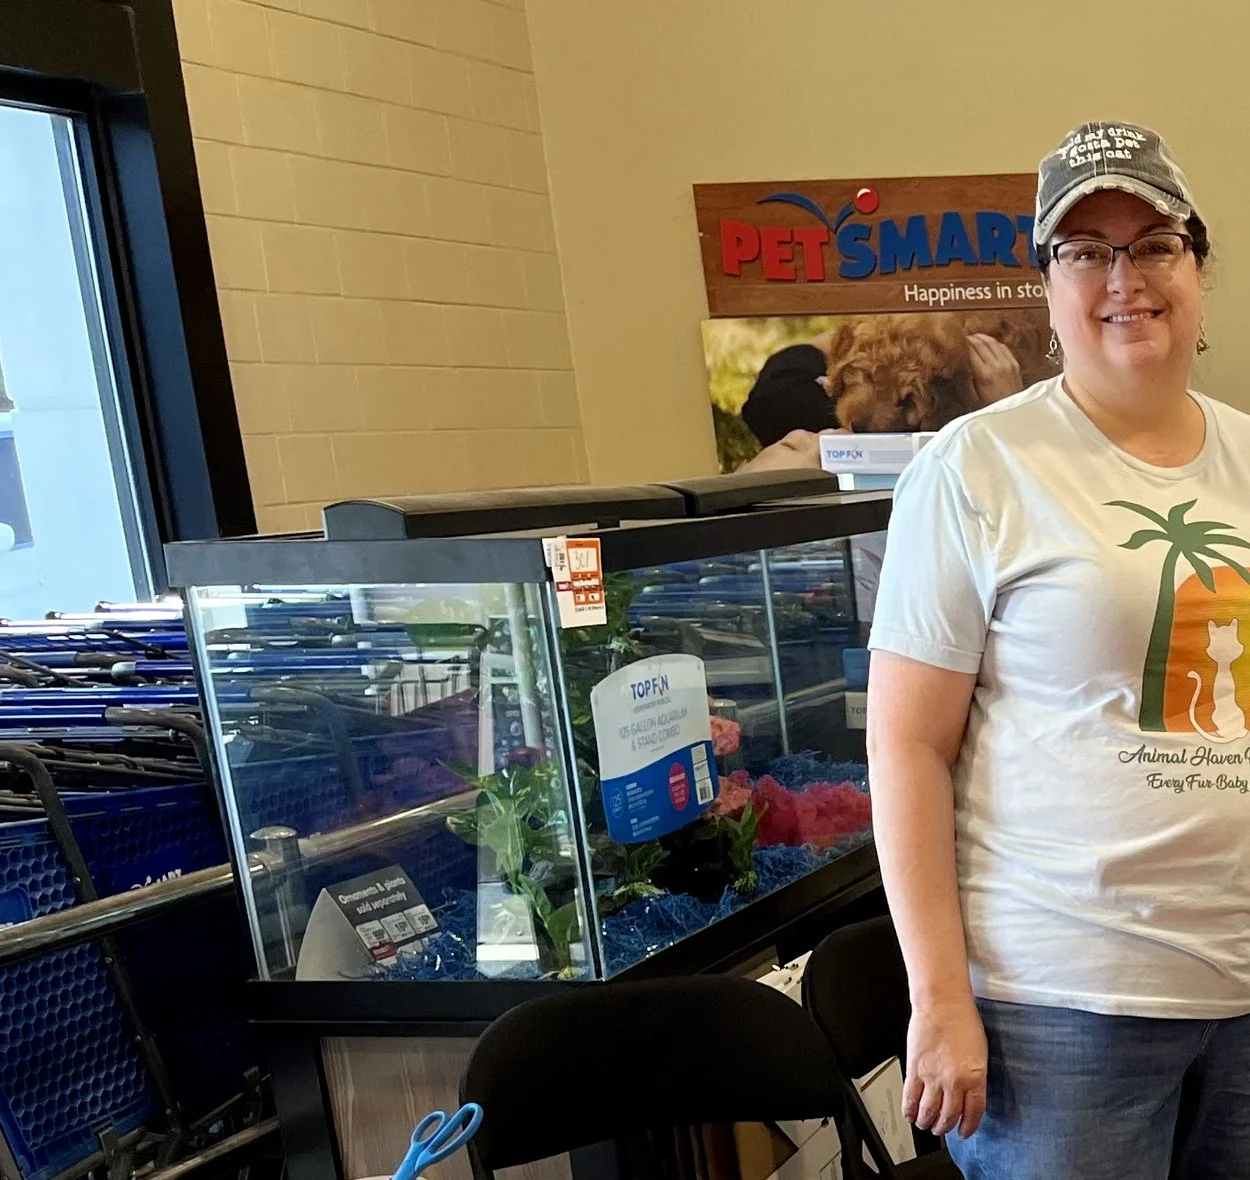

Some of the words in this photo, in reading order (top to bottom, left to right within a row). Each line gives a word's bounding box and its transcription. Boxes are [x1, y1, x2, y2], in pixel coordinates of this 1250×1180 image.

[1107, 127, 1147, 142] drink
[1114, 137, 1140, 149] pet
[1069, 152, 1102, 168] this
[1106, 149, 1132, 160] cat
[904, 283, 992, 307] Happiness
[996, 282, 1012, 300] in
[1017, 282, 1047, 299] sto
[1118, 744, 1188, 764] Animal
[1189, 746, 1243, 766] Haven
[1147, 772, 1185, 794] Every
